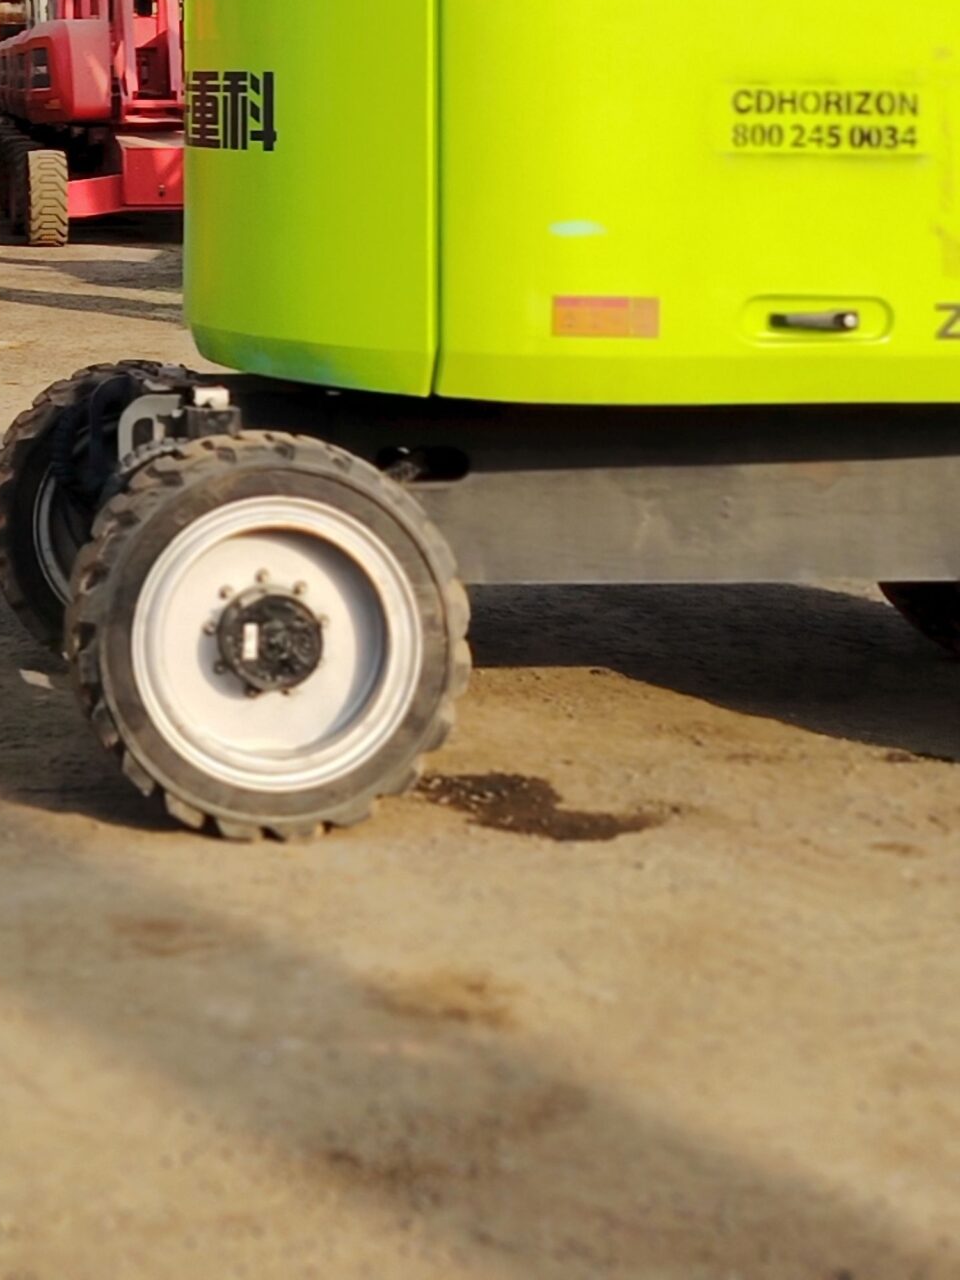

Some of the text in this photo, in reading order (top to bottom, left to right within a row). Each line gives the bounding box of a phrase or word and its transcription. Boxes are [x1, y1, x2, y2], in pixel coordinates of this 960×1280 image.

[186, 72, 277, 151] 重科
[732, 89, 919, 116] CDHORIZON
[732, 123, 917, 150] 800 245 0034
